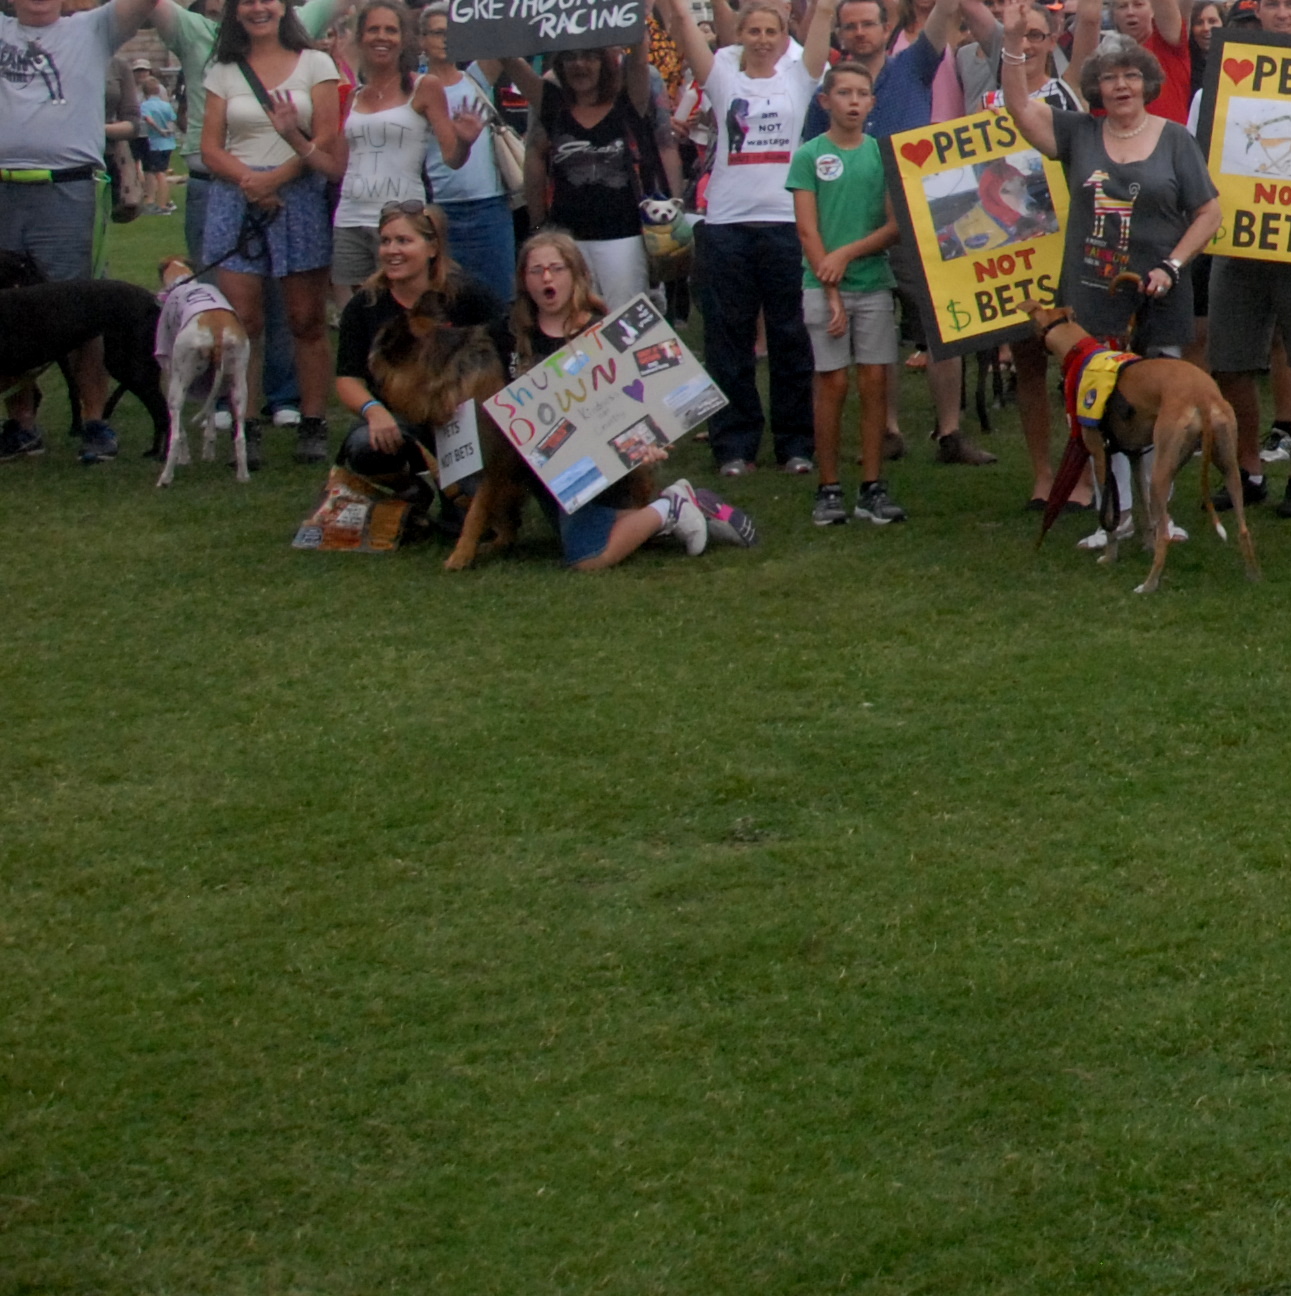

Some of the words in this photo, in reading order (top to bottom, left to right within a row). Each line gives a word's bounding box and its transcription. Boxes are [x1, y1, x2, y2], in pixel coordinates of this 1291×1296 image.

[528, 2, 639, 39] RACING
[758, 123, 783, 132] NOT
[761, 111, 778, 119] am
[746, 137, 790, 146] wastage
[932, 115, 1017, 164] PETS
[973, 247, 1036, 283] NOT
[974, 275, 1059, 324] BETS
[454, 441, 475, 463] BETS
